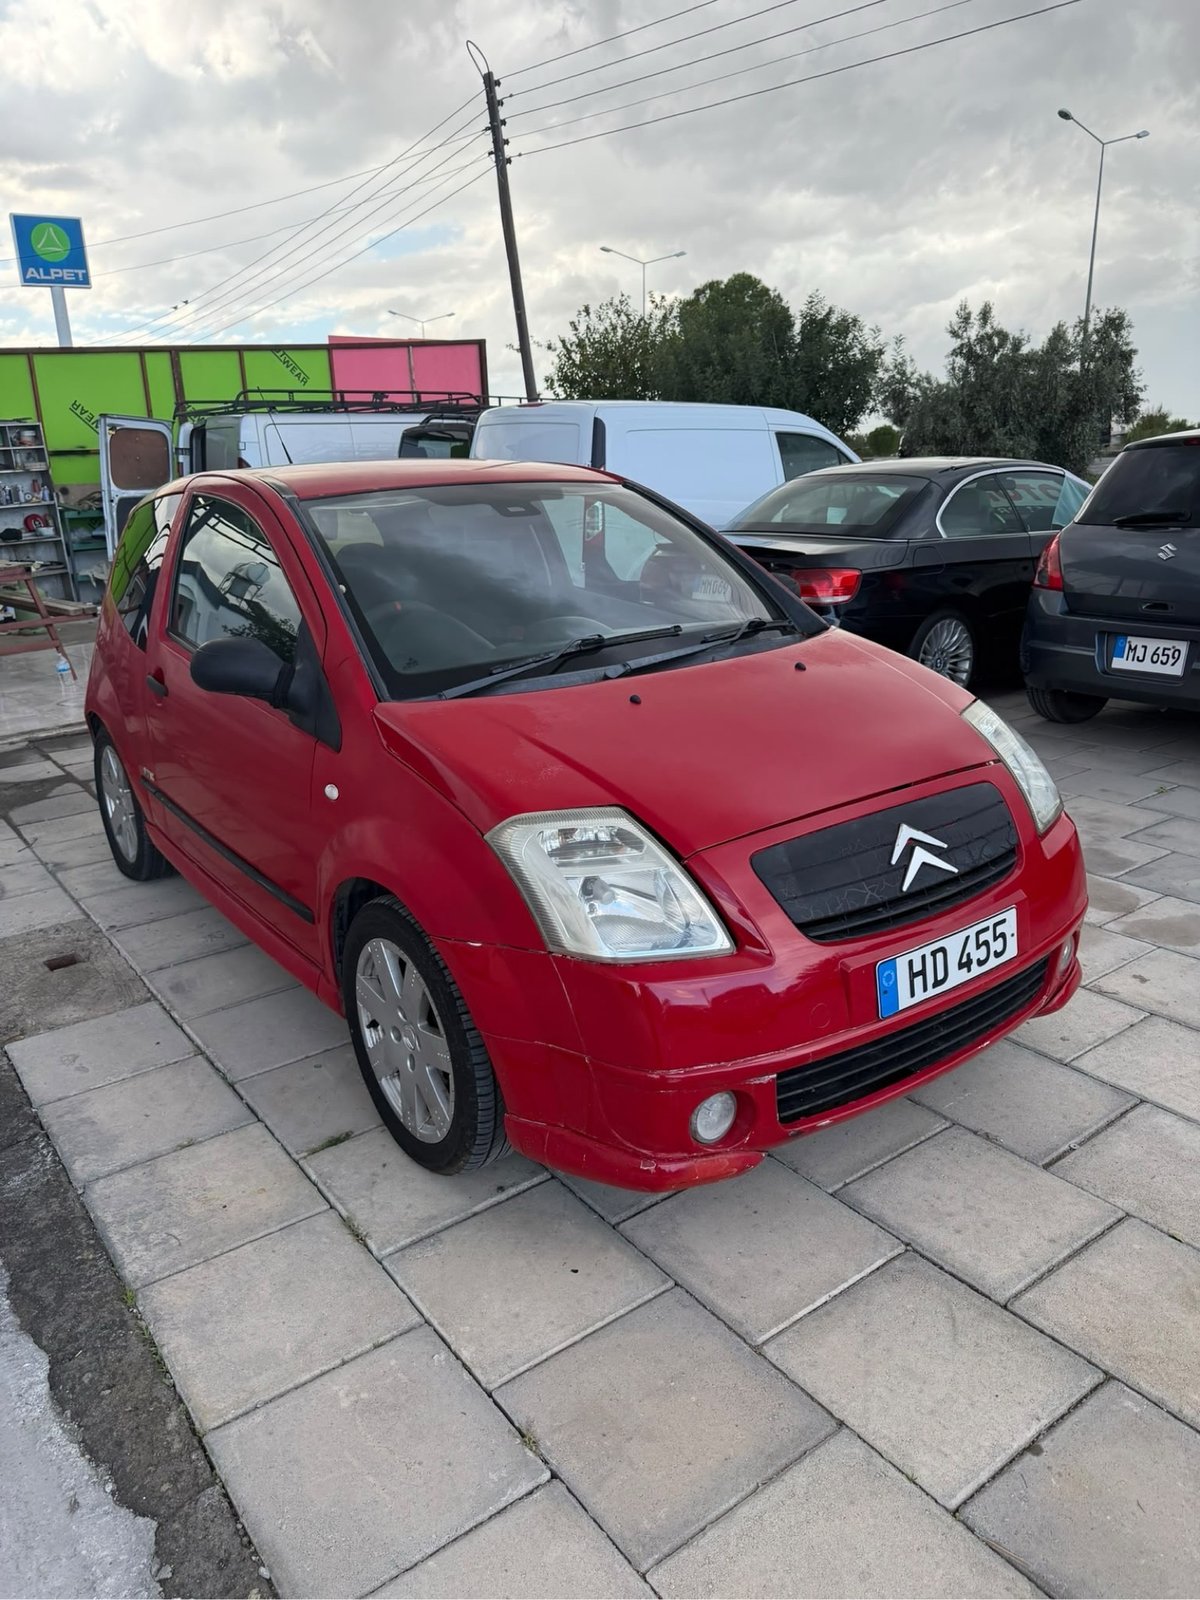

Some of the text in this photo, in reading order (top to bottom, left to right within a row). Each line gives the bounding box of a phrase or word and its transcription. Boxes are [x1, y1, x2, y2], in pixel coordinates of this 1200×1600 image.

[25, 267, 86, 281] ALPET
[276, 349, 309, 387] TWEAR
[1125, 644, 1181, 667] MJ 659
[908, 918, 1008, 999] HD 455
